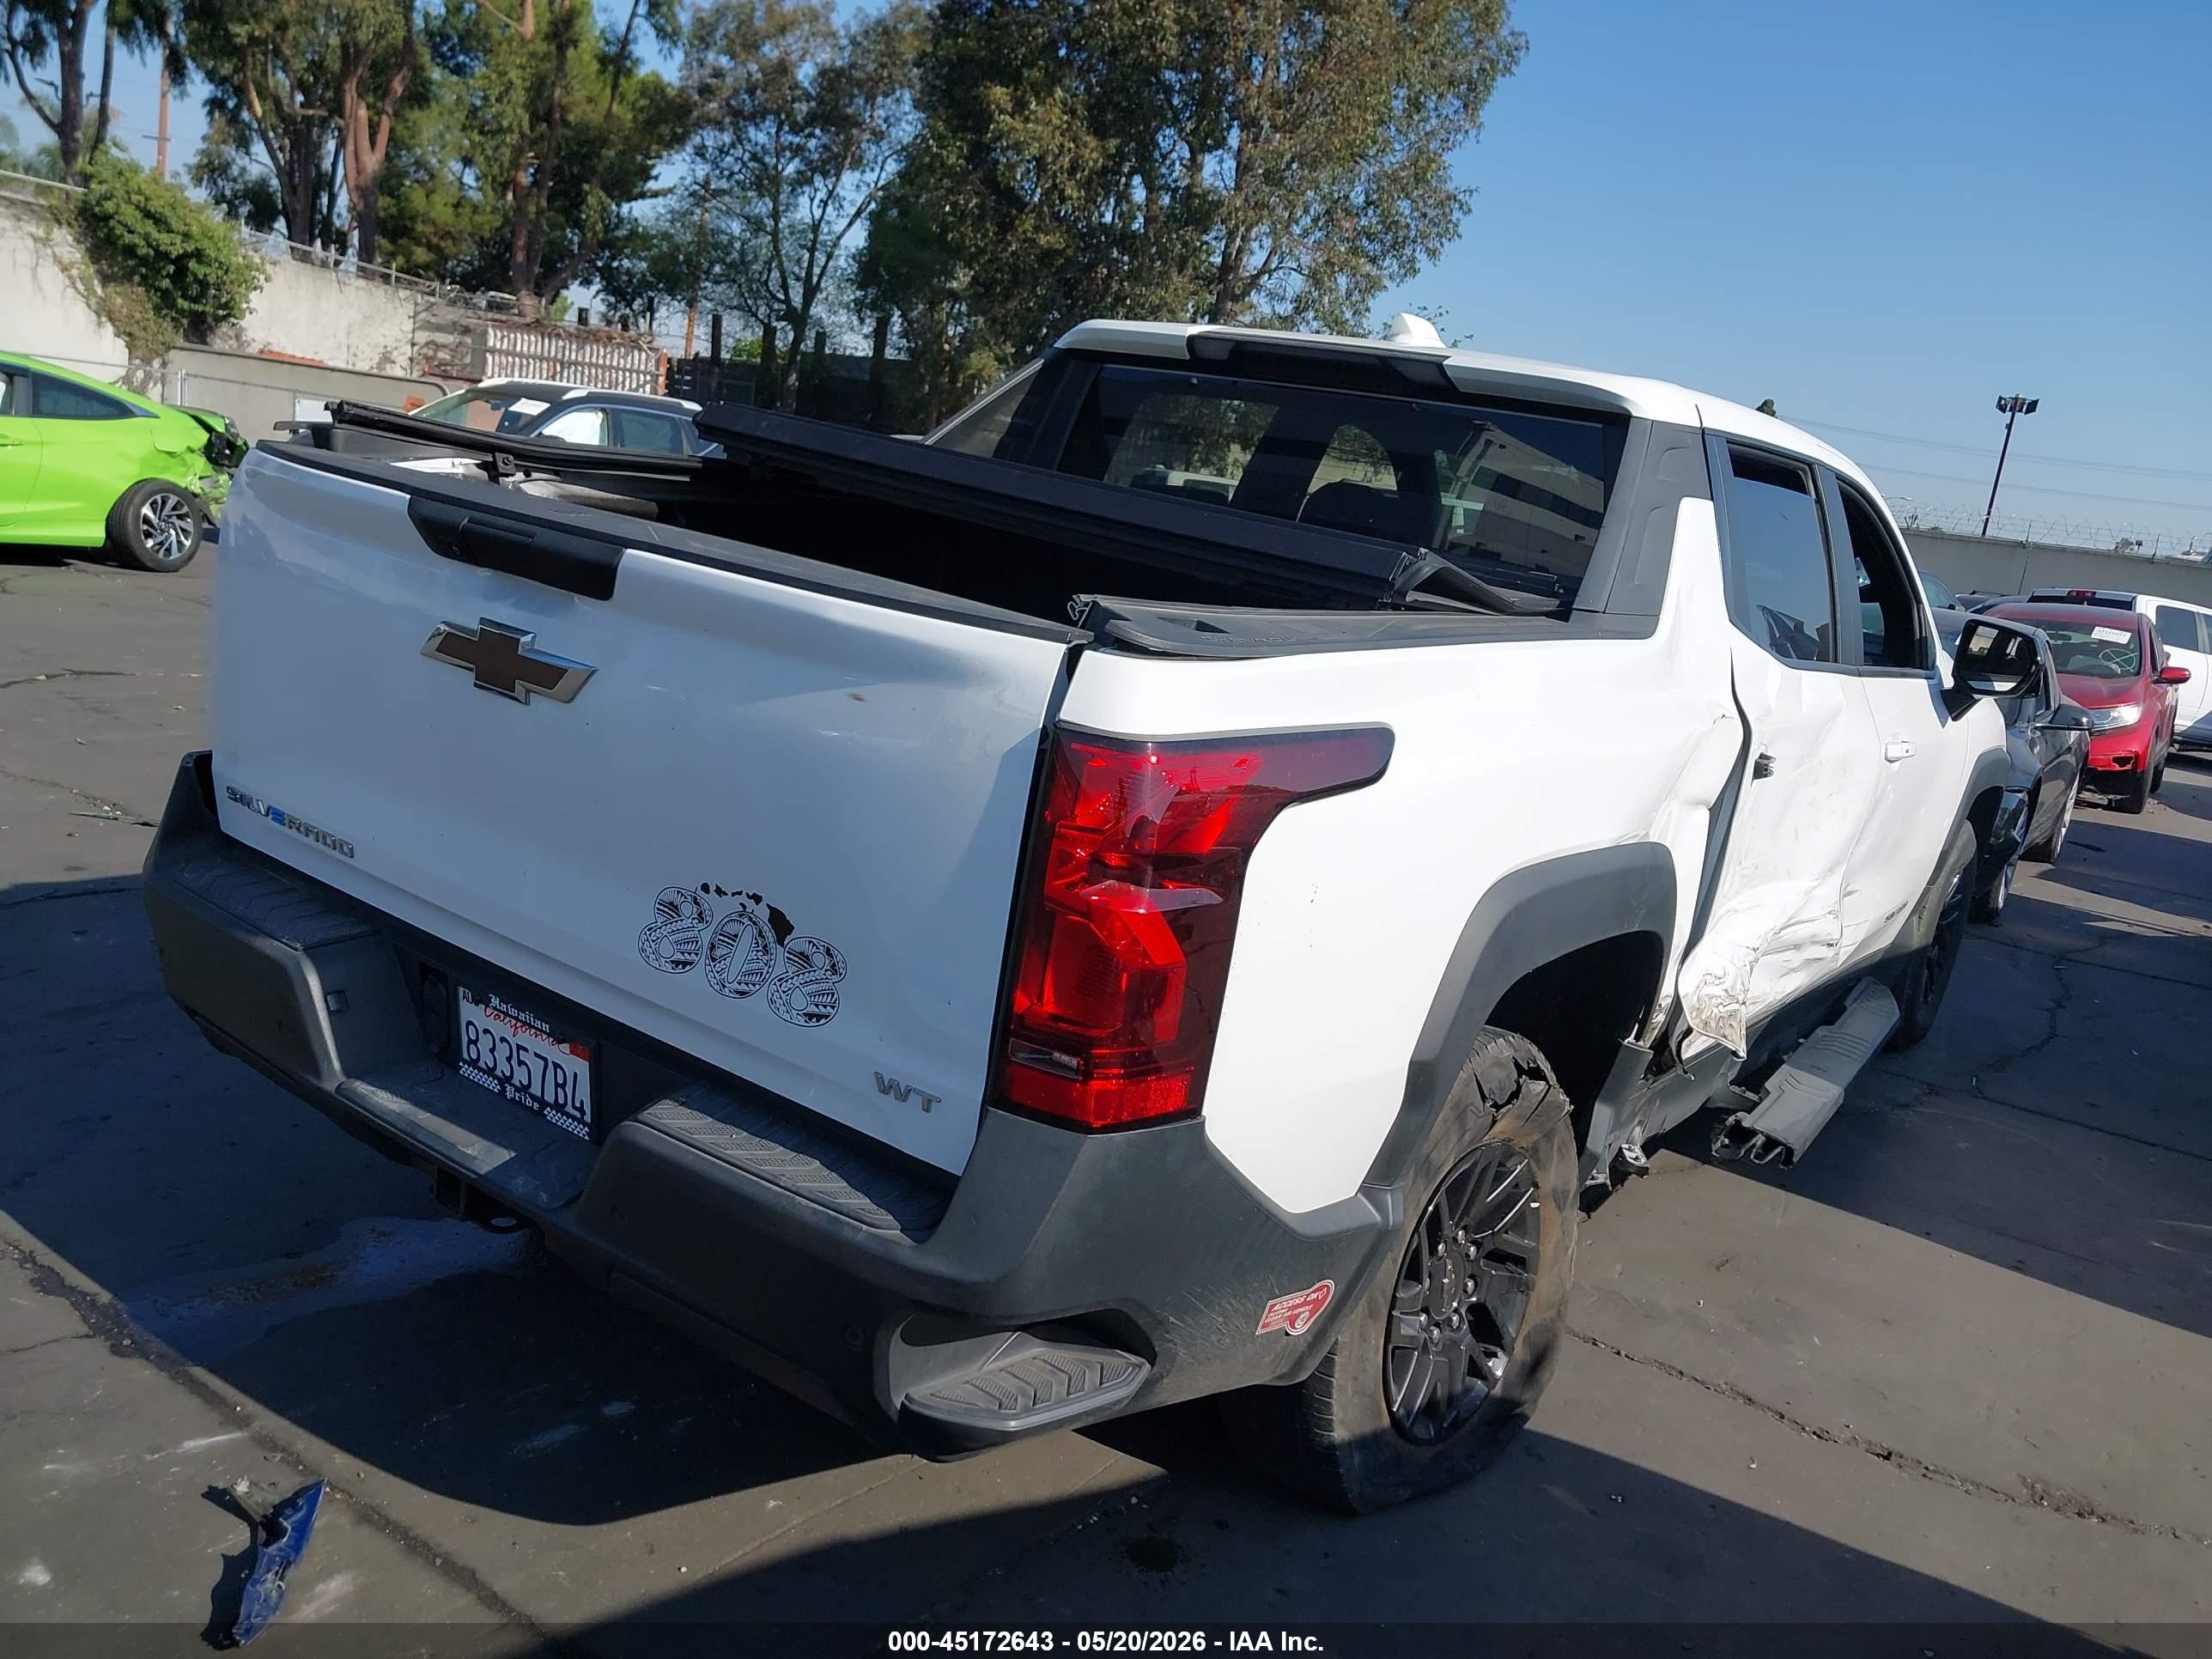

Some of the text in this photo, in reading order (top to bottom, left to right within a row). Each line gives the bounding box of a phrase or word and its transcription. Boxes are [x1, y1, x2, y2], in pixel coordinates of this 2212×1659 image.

[638, 887, 847, 1028] 808
[488, 994, 550, 1033] Hawaiian
[465, 1019, 587, 1120] 83357B4
[504, 1084, 540, 1110] Pride
[873, 1071, 942, 1114] WT
